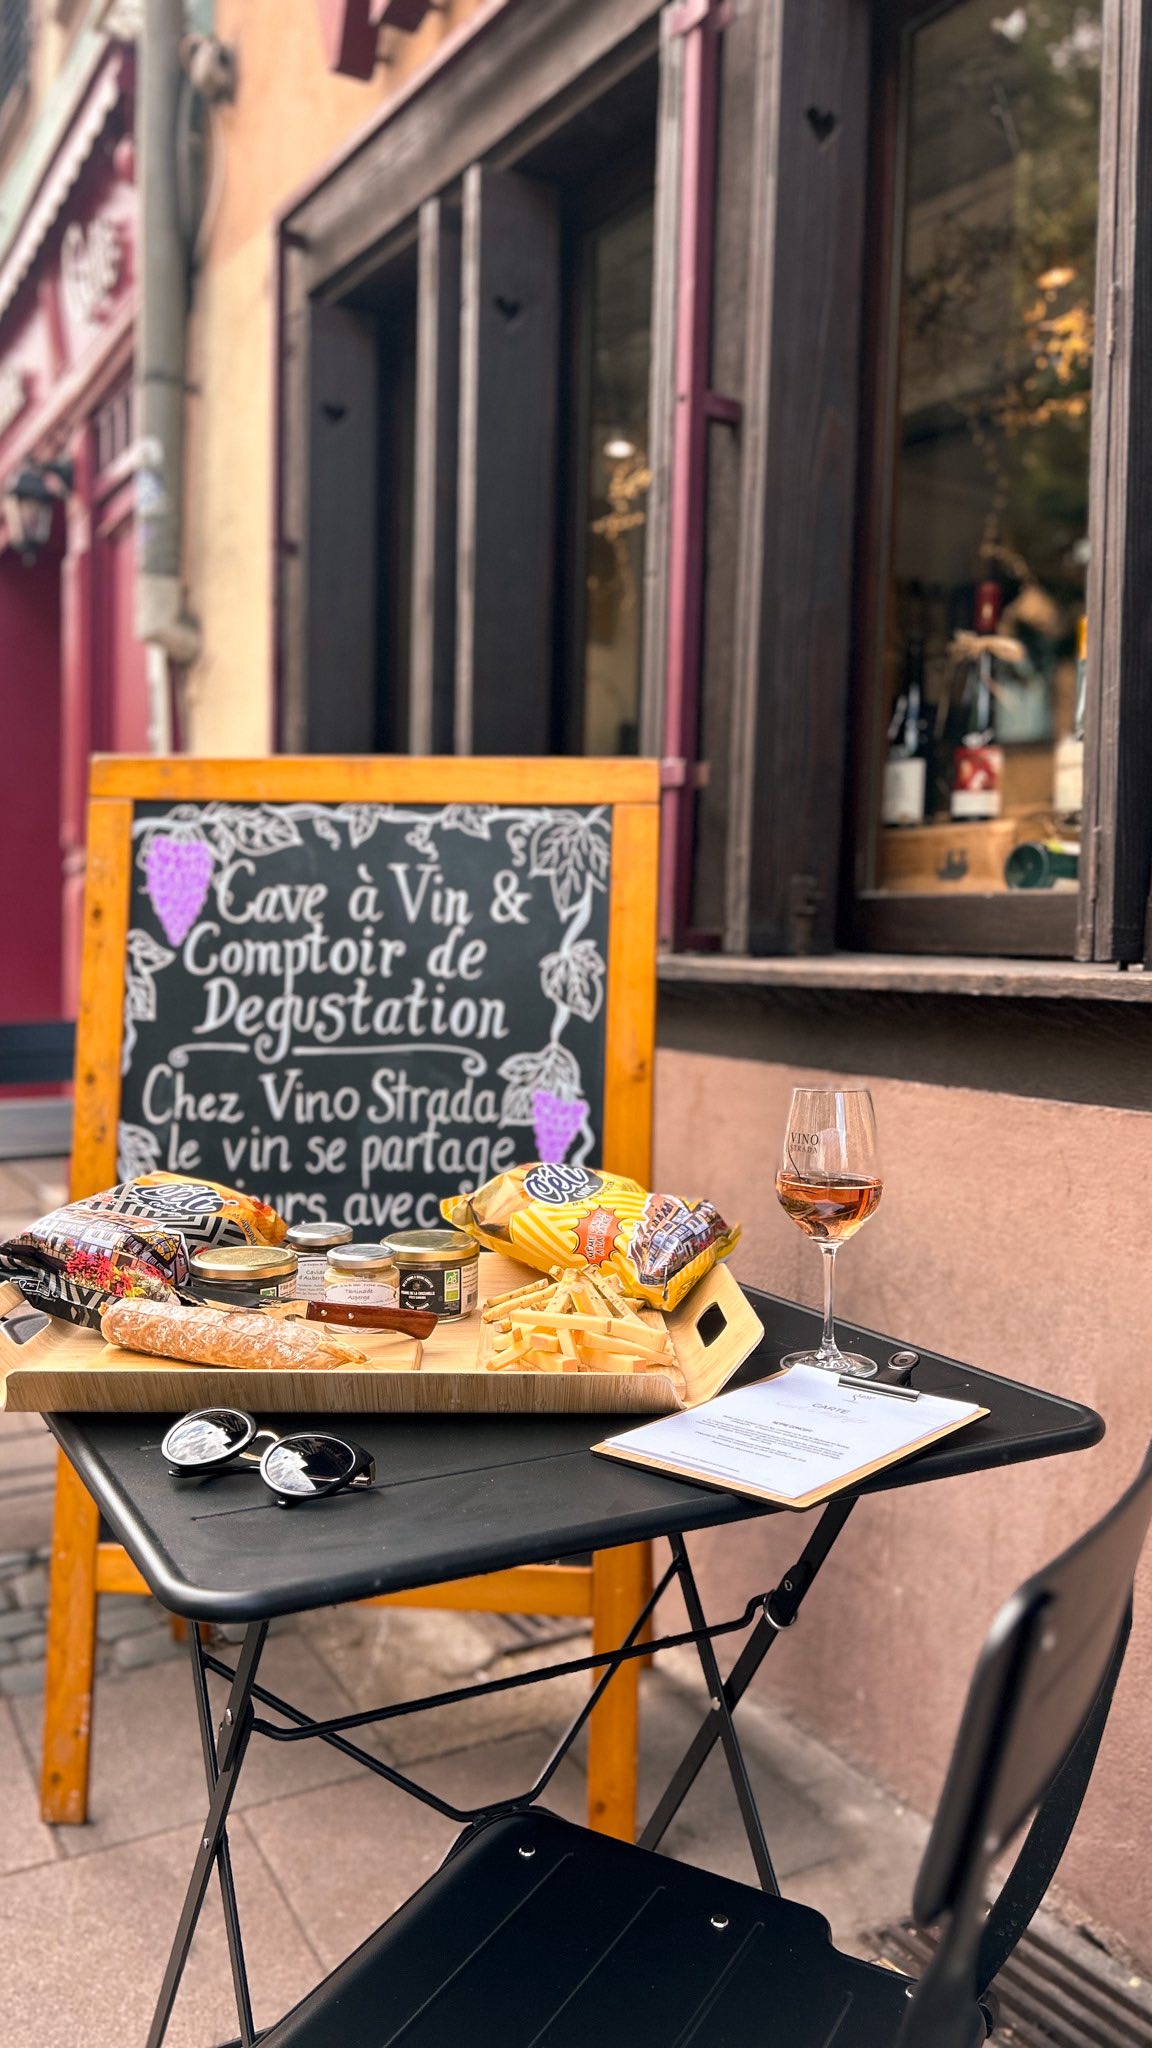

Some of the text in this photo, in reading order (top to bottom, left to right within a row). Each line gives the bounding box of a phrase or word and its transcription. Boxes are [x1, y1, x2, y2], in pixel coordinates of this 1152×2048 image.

[215, 859, 533, 926] Cave à Vin &
[183, 921, 488, 992] Comptoir de
[192, 976, 510, 1065] Degustation
[142, 1063, 500, 1126] Chez Vino Strada
[168, 1121, 517, 1190] le vin se partage
[790, 1144, 818, 1154] STRADA
[791, 1131, 819, 1146] VINO
[342, 1191, 441, 1229] avec
[811, 1402, 852, 1415] CARTE
